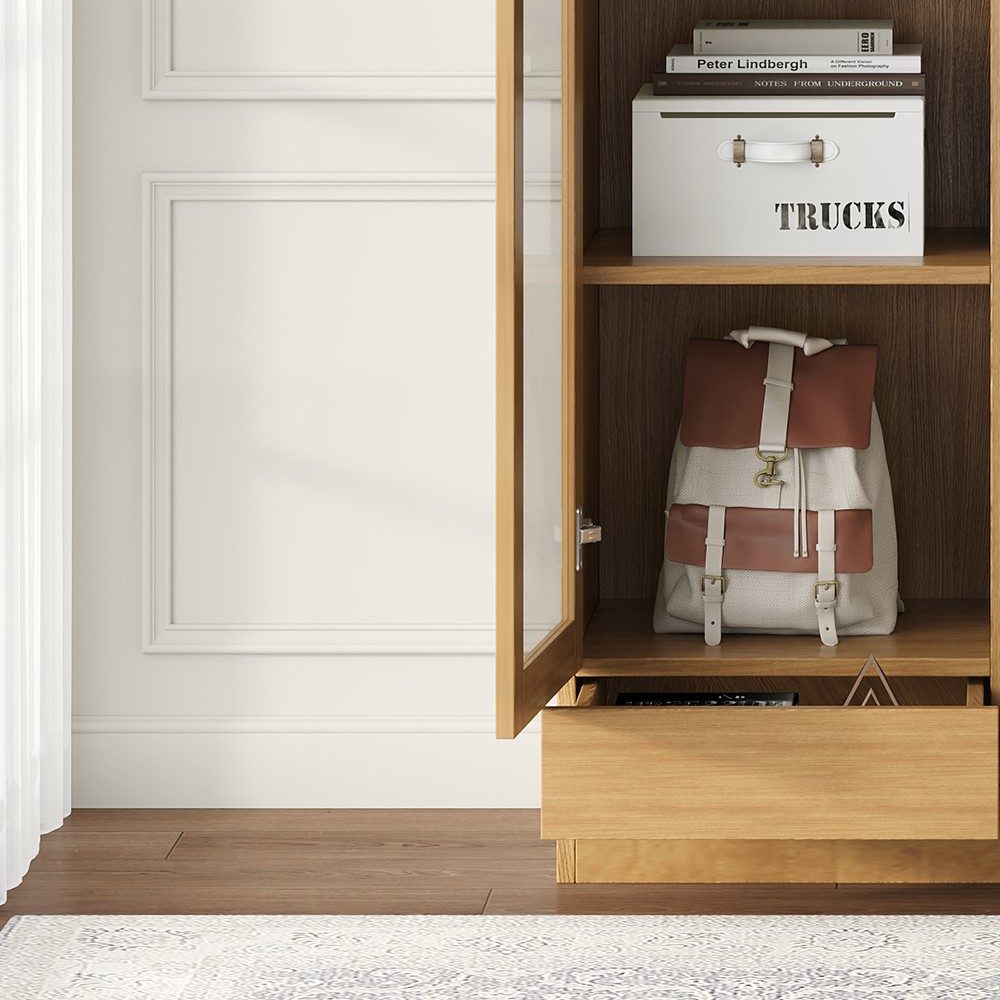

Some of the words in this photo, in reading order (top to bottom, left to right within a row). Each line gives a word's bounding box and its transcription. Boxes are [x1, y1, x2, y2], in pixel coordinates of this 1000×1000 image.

[861, 32, 870, 53] EERO
[697, 59, 734, 69] Peter
[737, 59, 808, 72] Lindbergh
[827, 80, 903, 88] UNDERGROUND
[774, 201, 906, 231] TRUCKS
